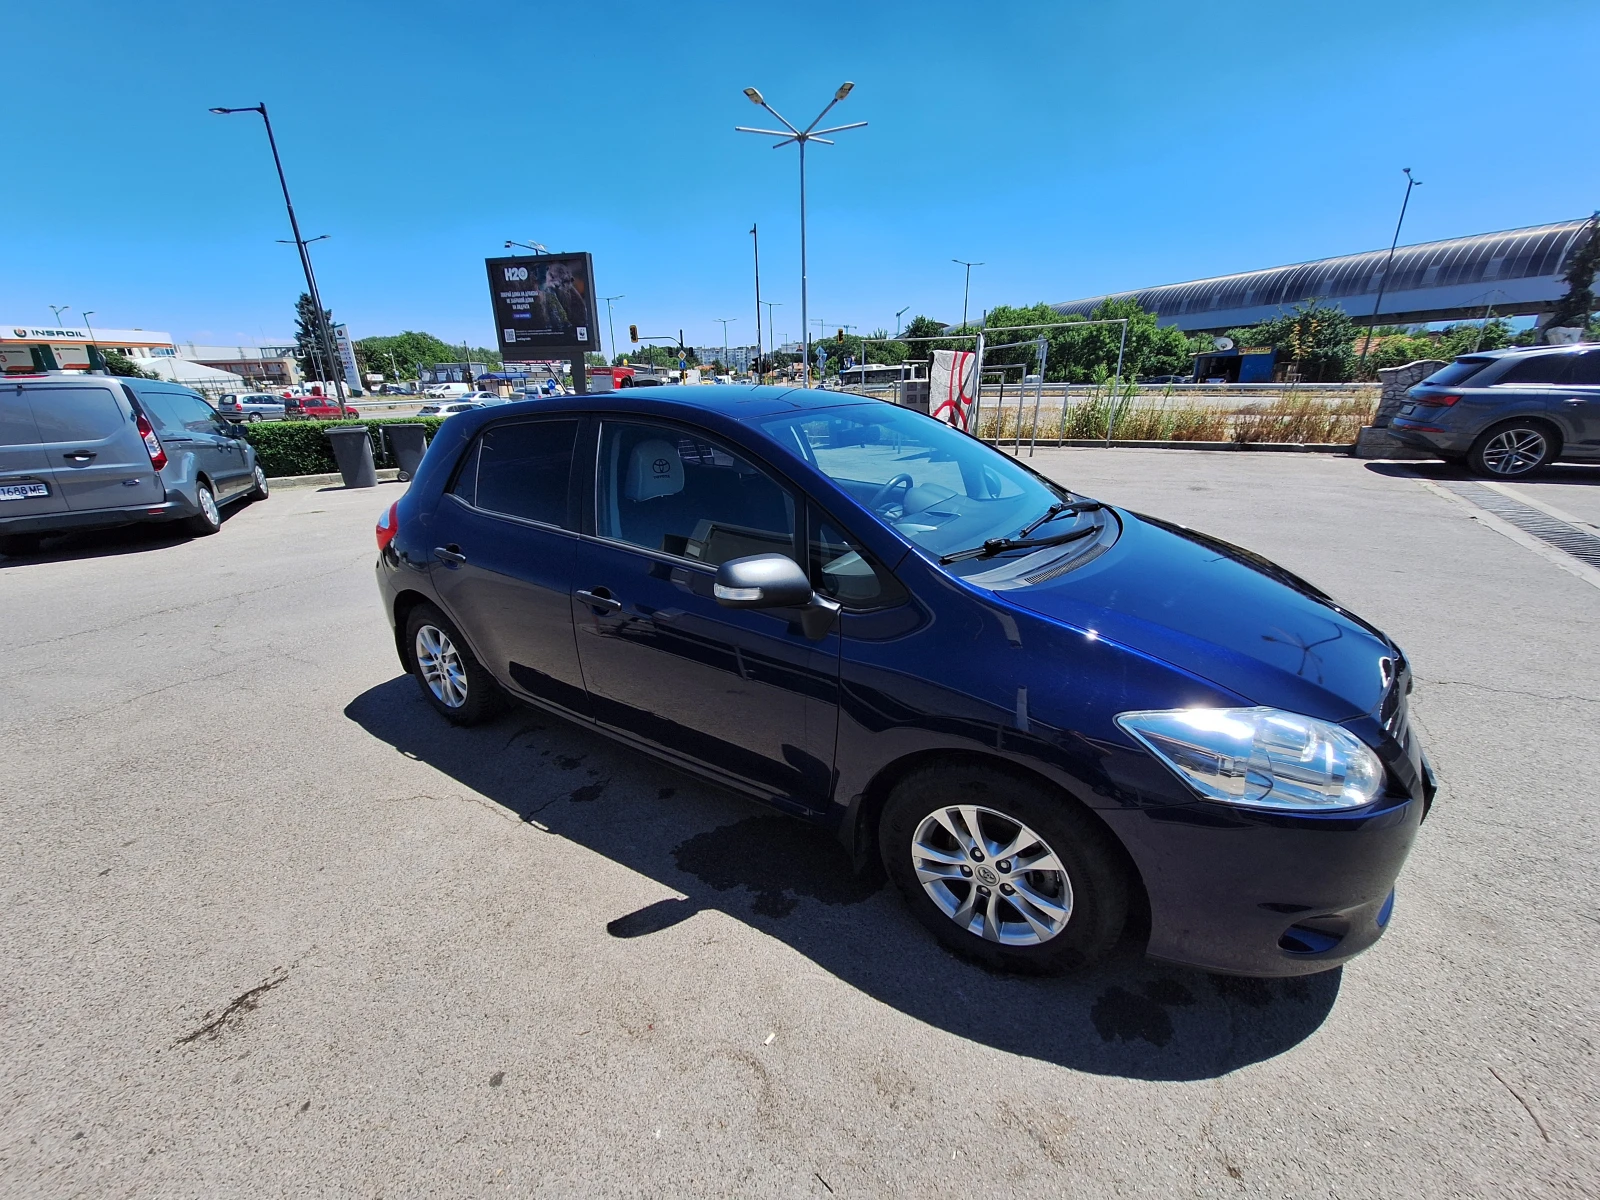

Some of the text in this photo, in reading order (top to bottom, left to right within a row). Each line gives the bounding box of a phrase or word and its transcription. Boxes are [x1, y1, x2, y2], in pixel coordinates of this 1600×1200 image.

[504, 267, 528, 281] H2O
[1, 485, 45, 496] 1688 ME
